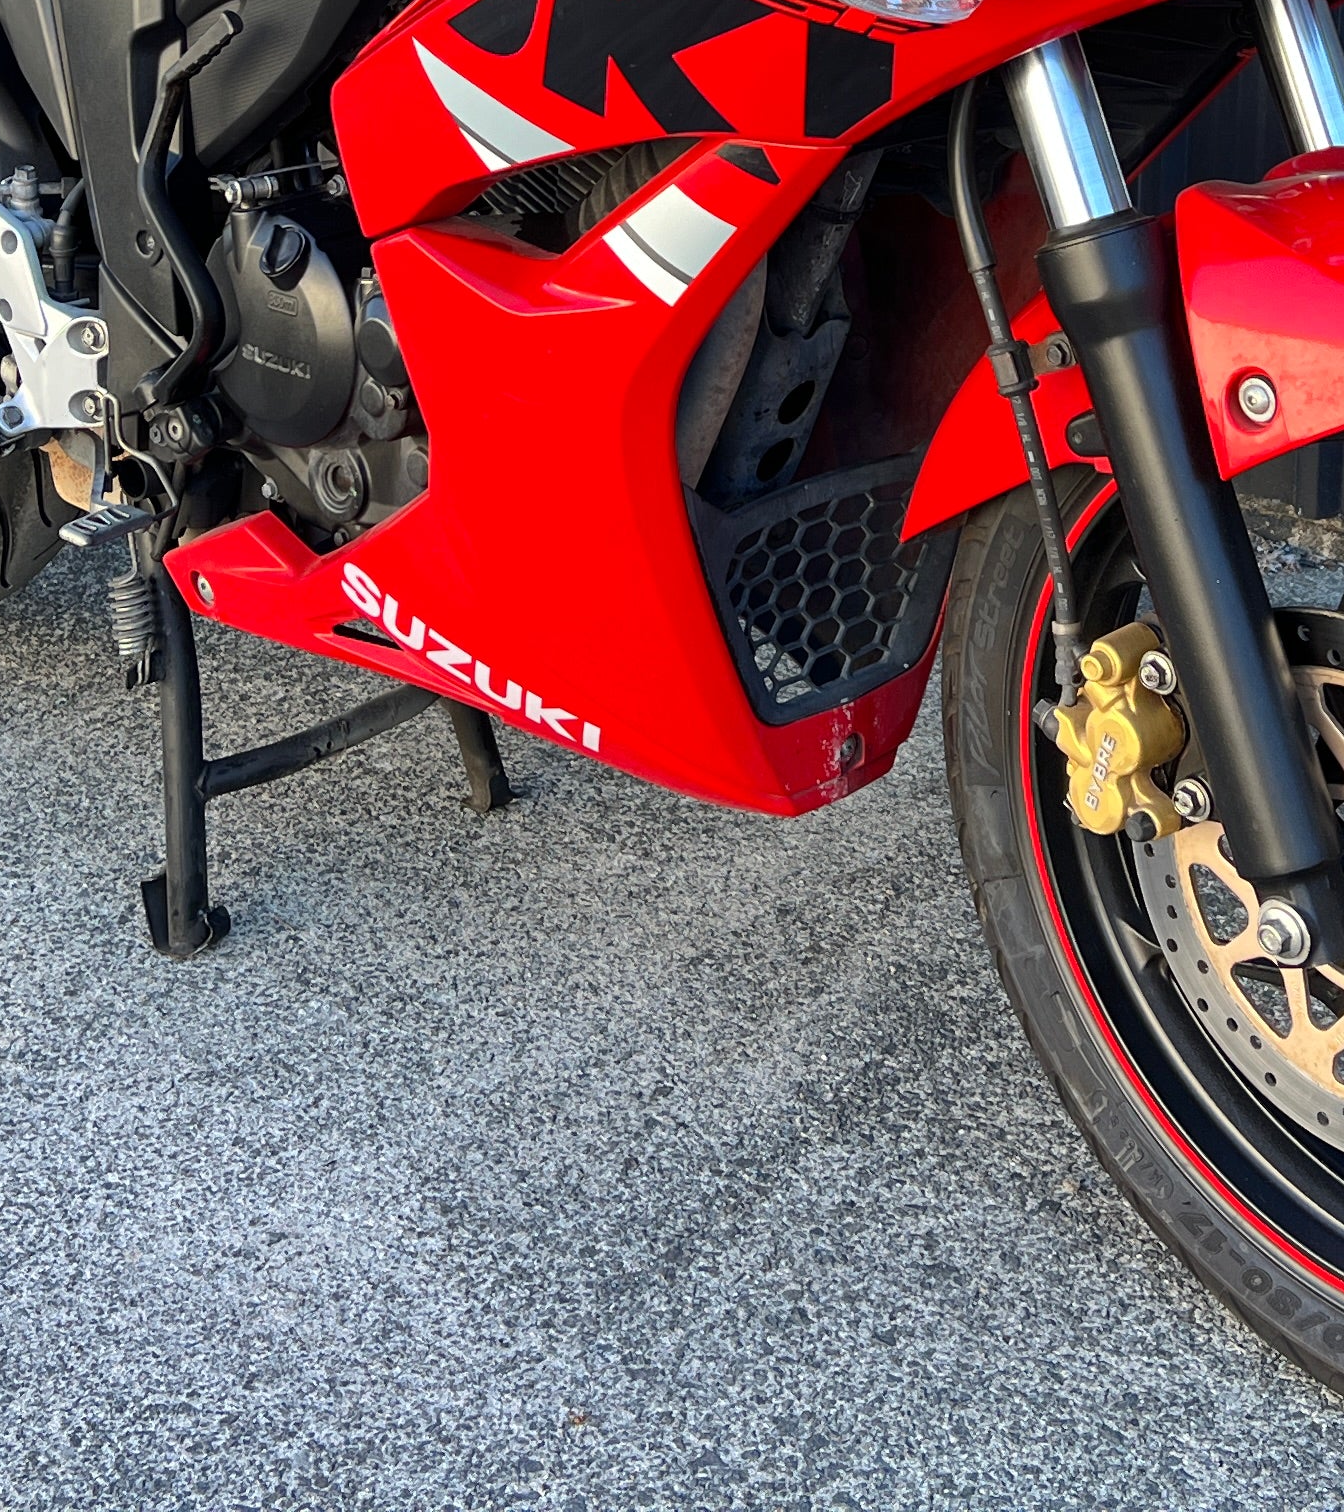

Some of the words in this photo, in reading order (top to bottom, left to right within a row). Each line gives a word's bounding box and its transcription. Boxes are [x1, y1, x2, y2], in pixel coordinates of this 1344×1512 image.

[242, 343, 311, 379] SUZUKI
[972, 524, 1025, 651] Street
[341, 562, 601, 753] SUZUKI
[1085, 732, 1117, 811] BYBRE
